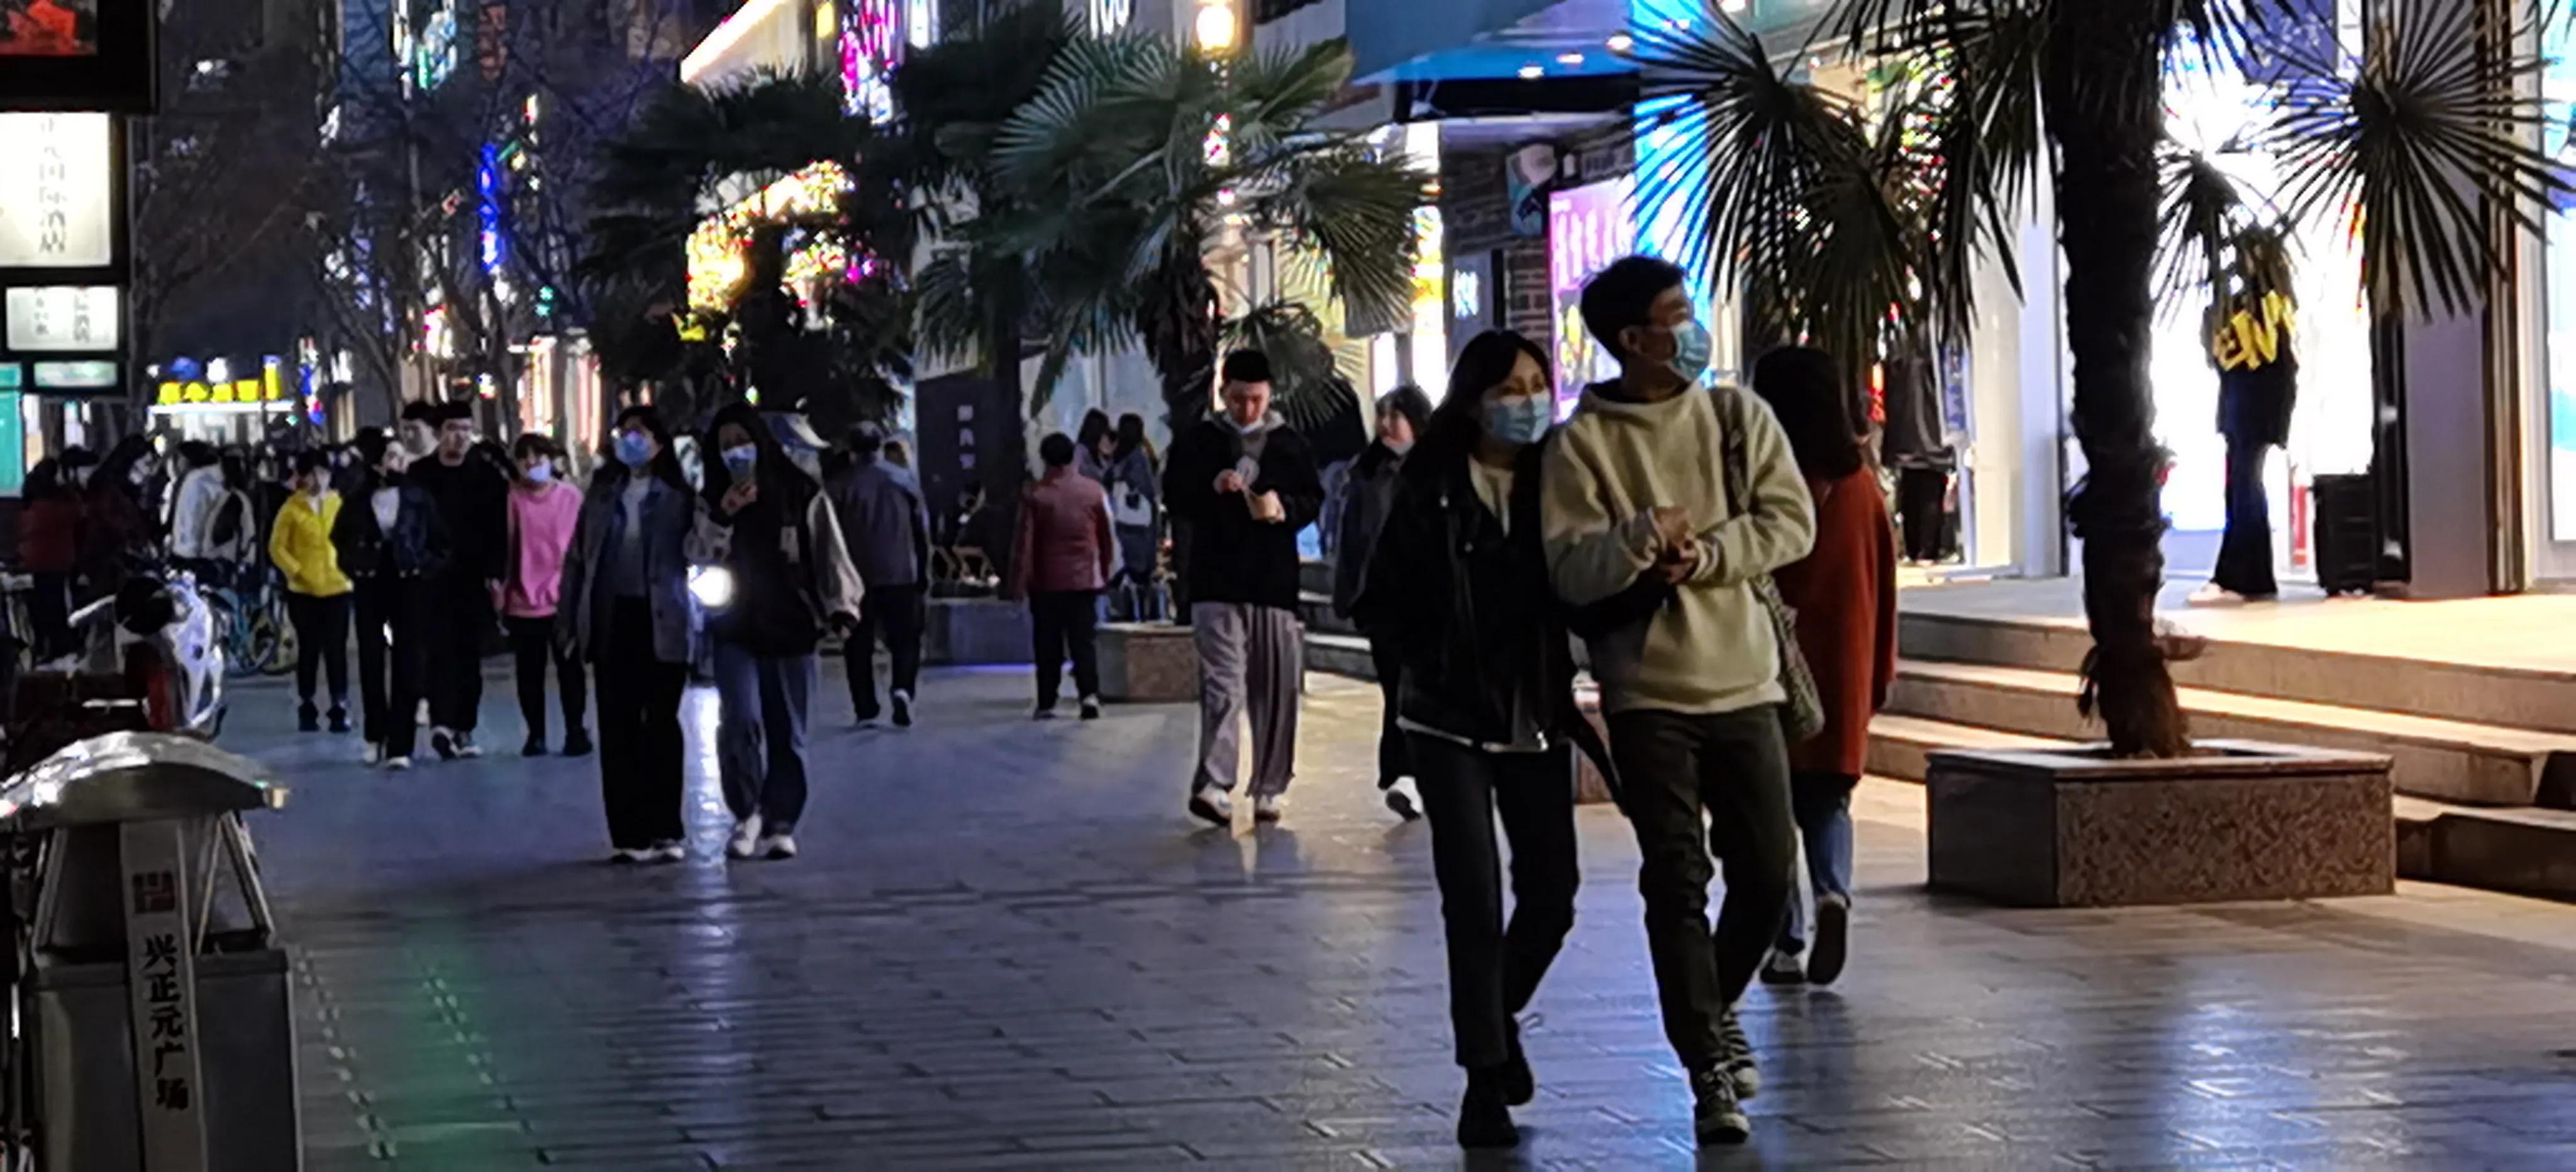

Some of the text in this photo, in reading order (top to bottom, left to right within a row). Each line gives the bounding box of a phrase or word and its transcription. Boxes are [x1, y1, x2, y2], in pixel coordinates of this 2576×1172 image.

[142, 934, 189, 1111] 兴正元广场
